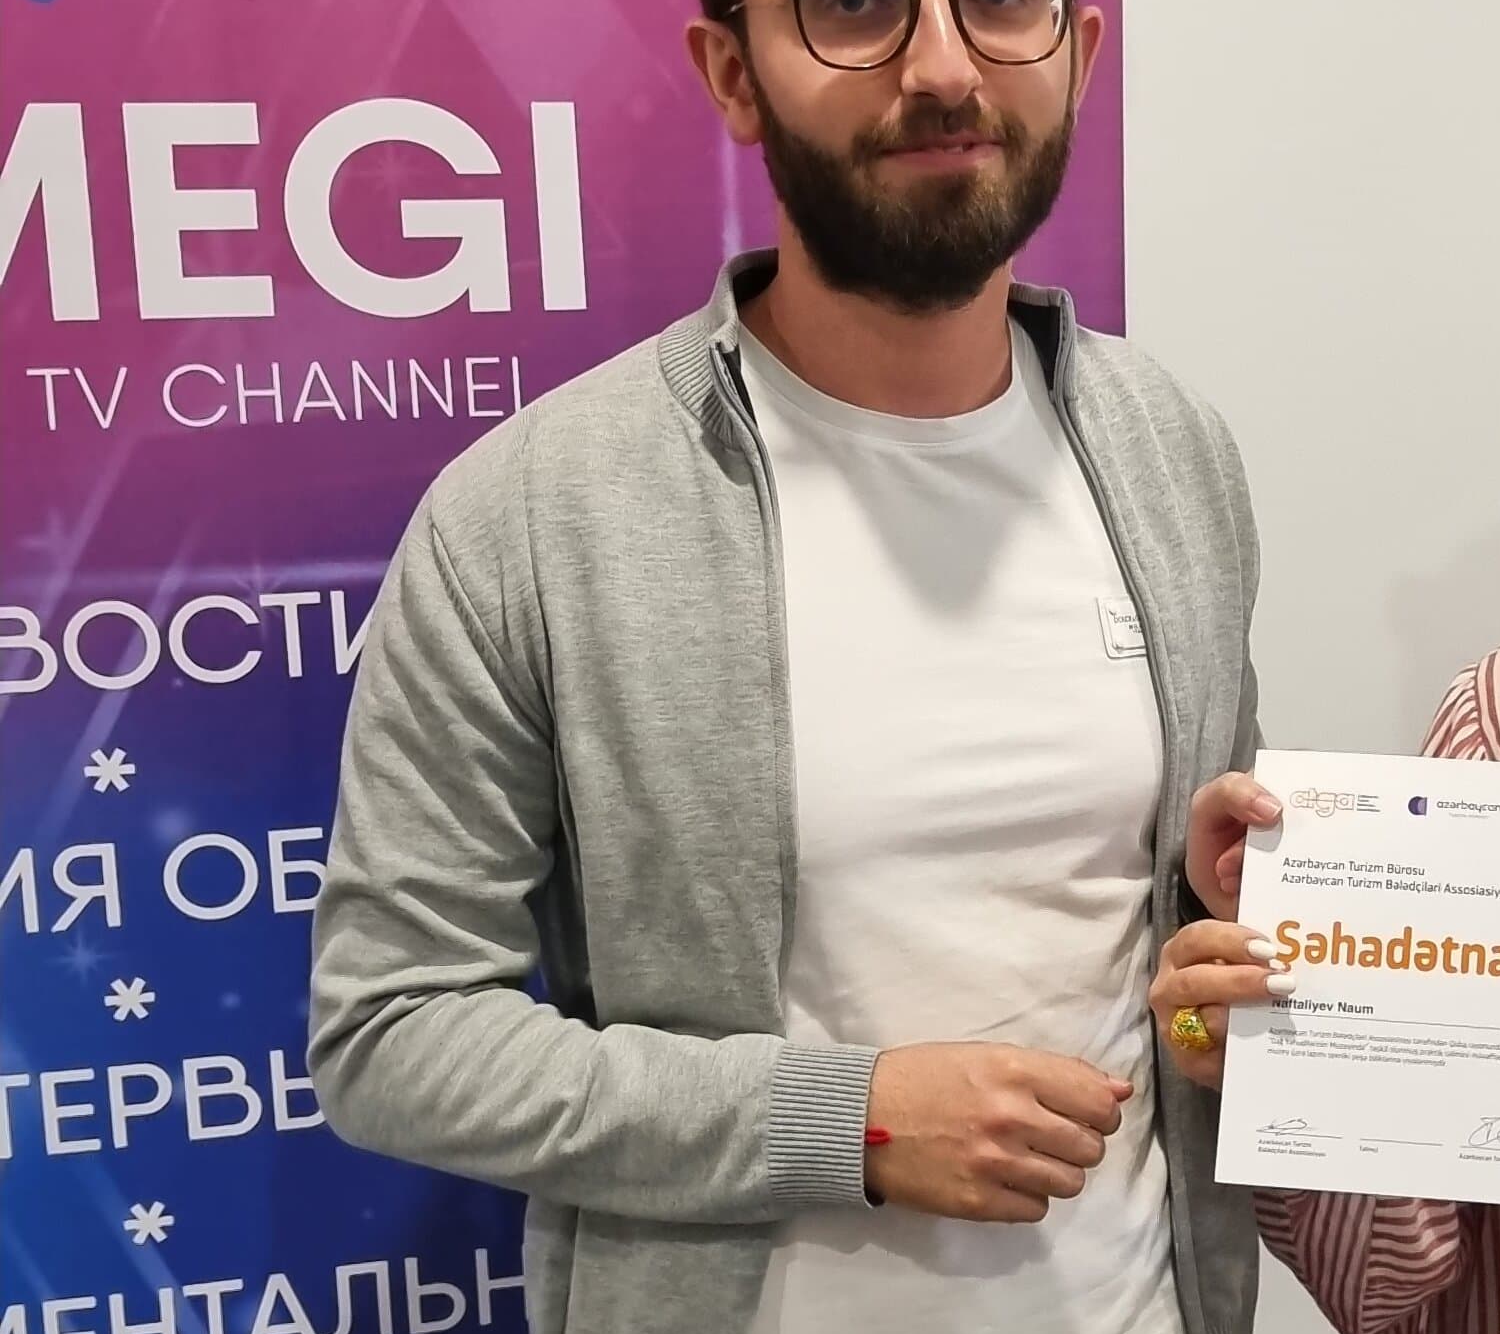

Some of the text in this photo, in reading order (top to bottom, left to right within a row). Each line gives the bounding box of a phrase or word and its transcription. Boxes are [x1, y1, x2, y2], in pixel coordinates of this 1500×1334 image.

[26, 366, 128, 431] TV
[1349, 860, 1384, 873] Turizm
[1347, 876, 1382, 889] Turizm
[1272, 997, 1374, 1014] Naftaliyev Naum
